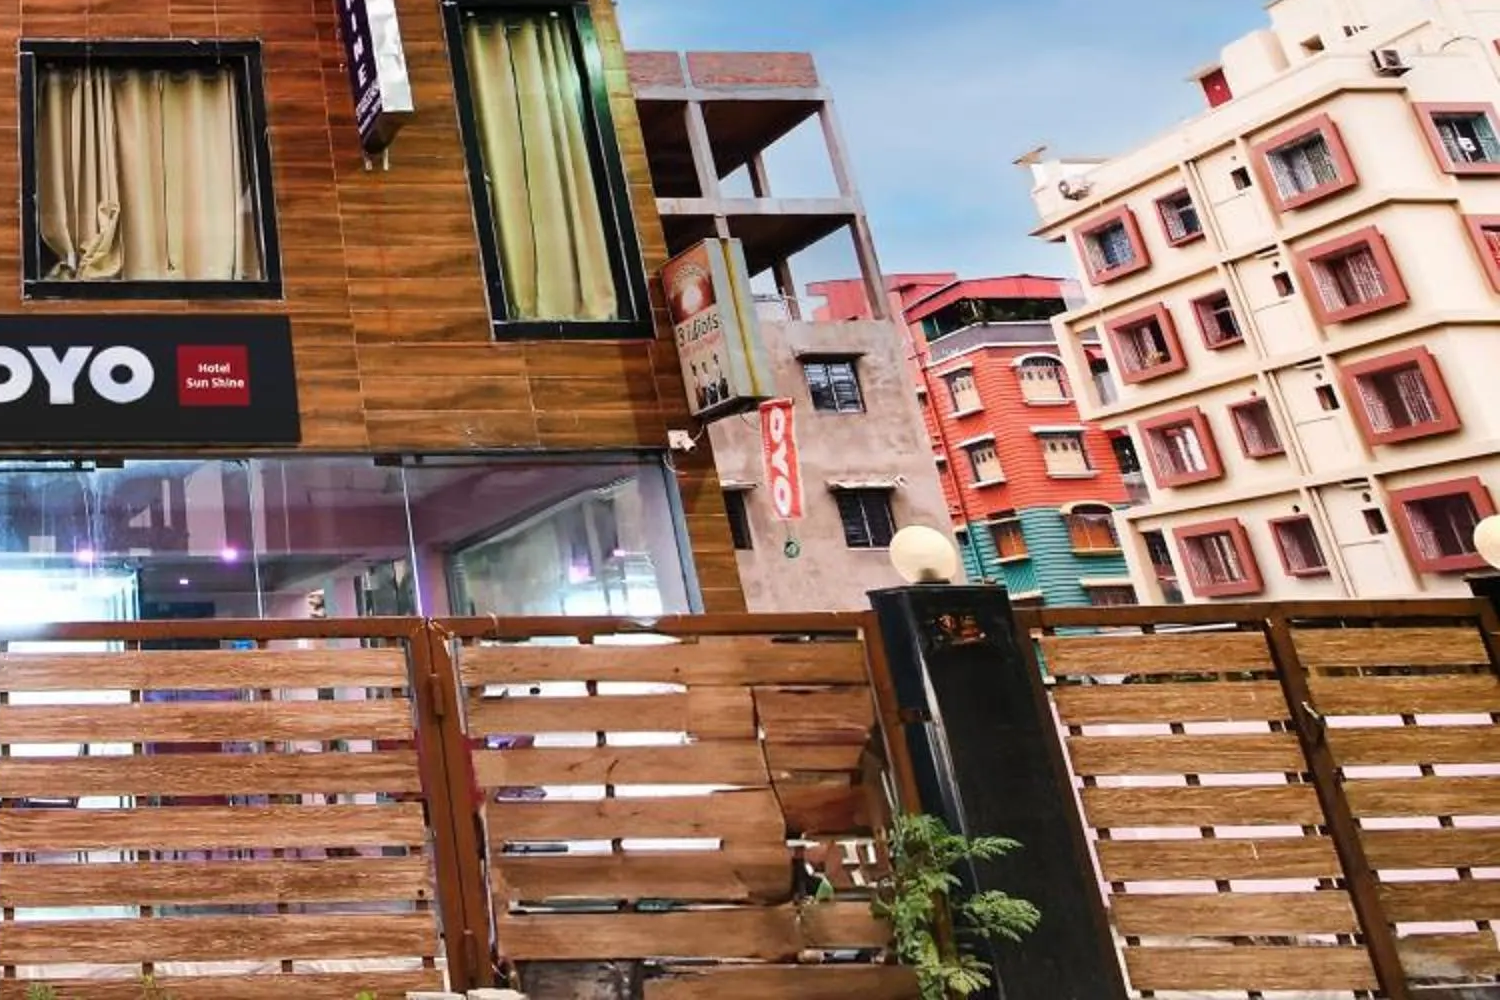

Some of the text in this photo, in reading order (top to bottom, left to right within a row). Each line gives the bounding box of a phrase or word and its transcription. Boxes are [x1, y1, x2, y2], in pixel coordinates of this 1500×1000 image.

[197, 362, 231, 374] Hotel
[186, 377, 245, 389] Sun Shine
[769, 406, 793, 517] OYO
